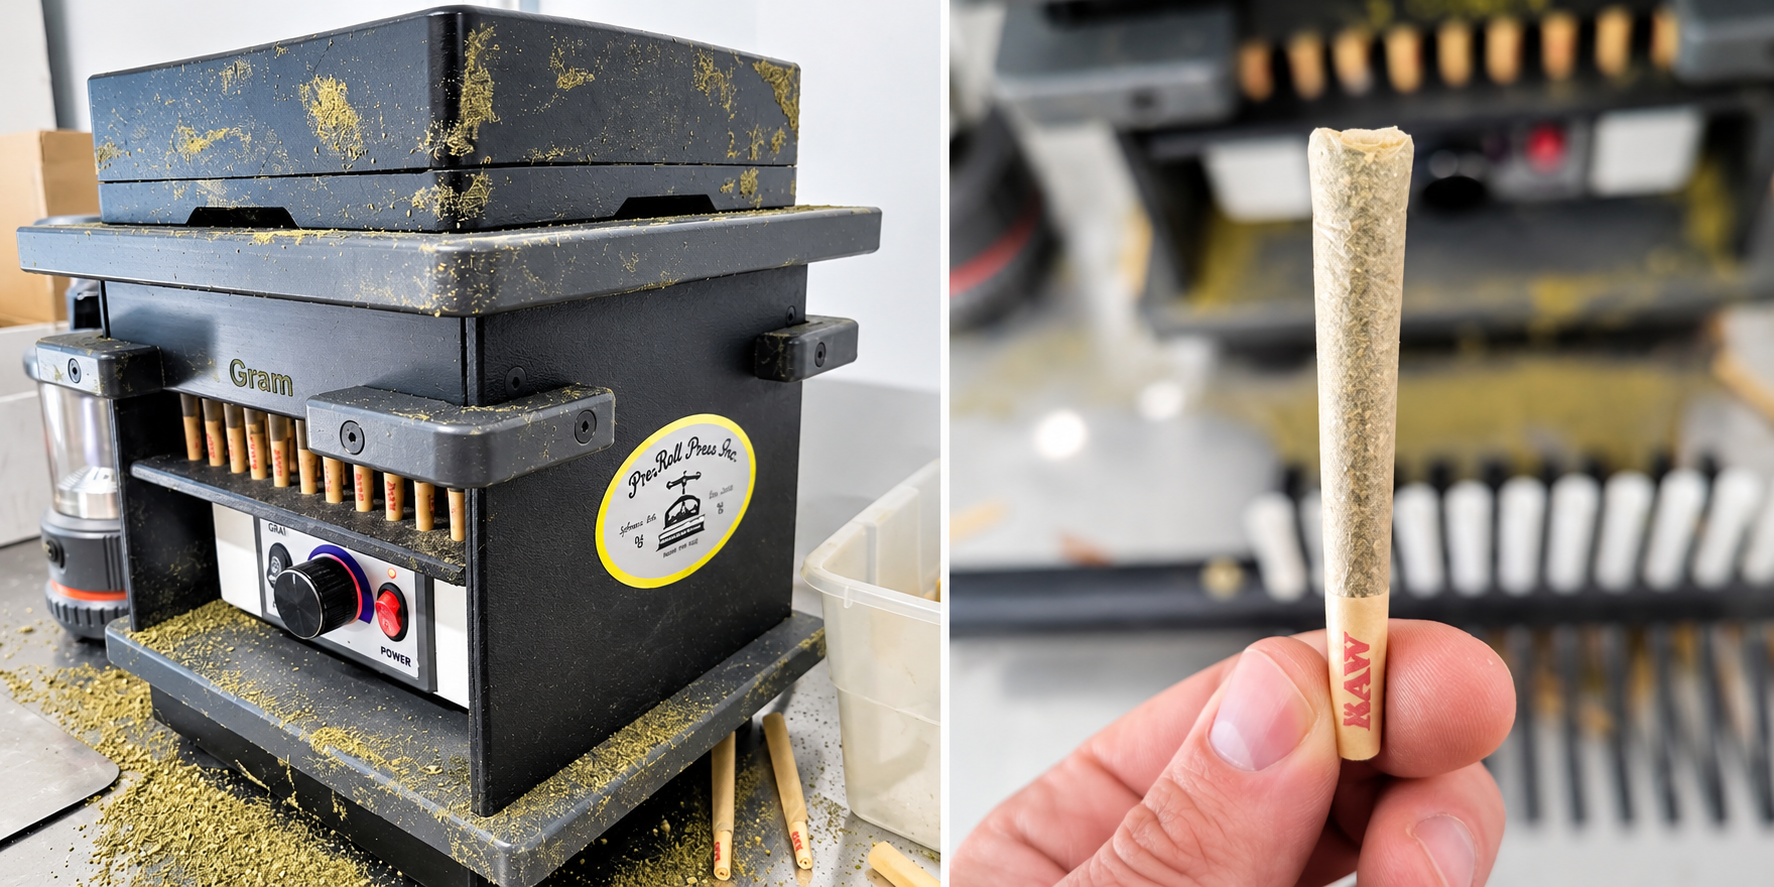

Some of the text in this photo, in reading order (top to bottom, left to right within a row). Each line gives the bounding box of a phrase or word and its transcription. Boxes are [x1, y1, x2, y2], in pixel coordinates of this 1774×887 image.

[229, 358, 294, 397] Gram
[685, 436, 717, 460] Press
[718, 438, 737, 462] Inc.
[380, 645, 411, 667] POWER
